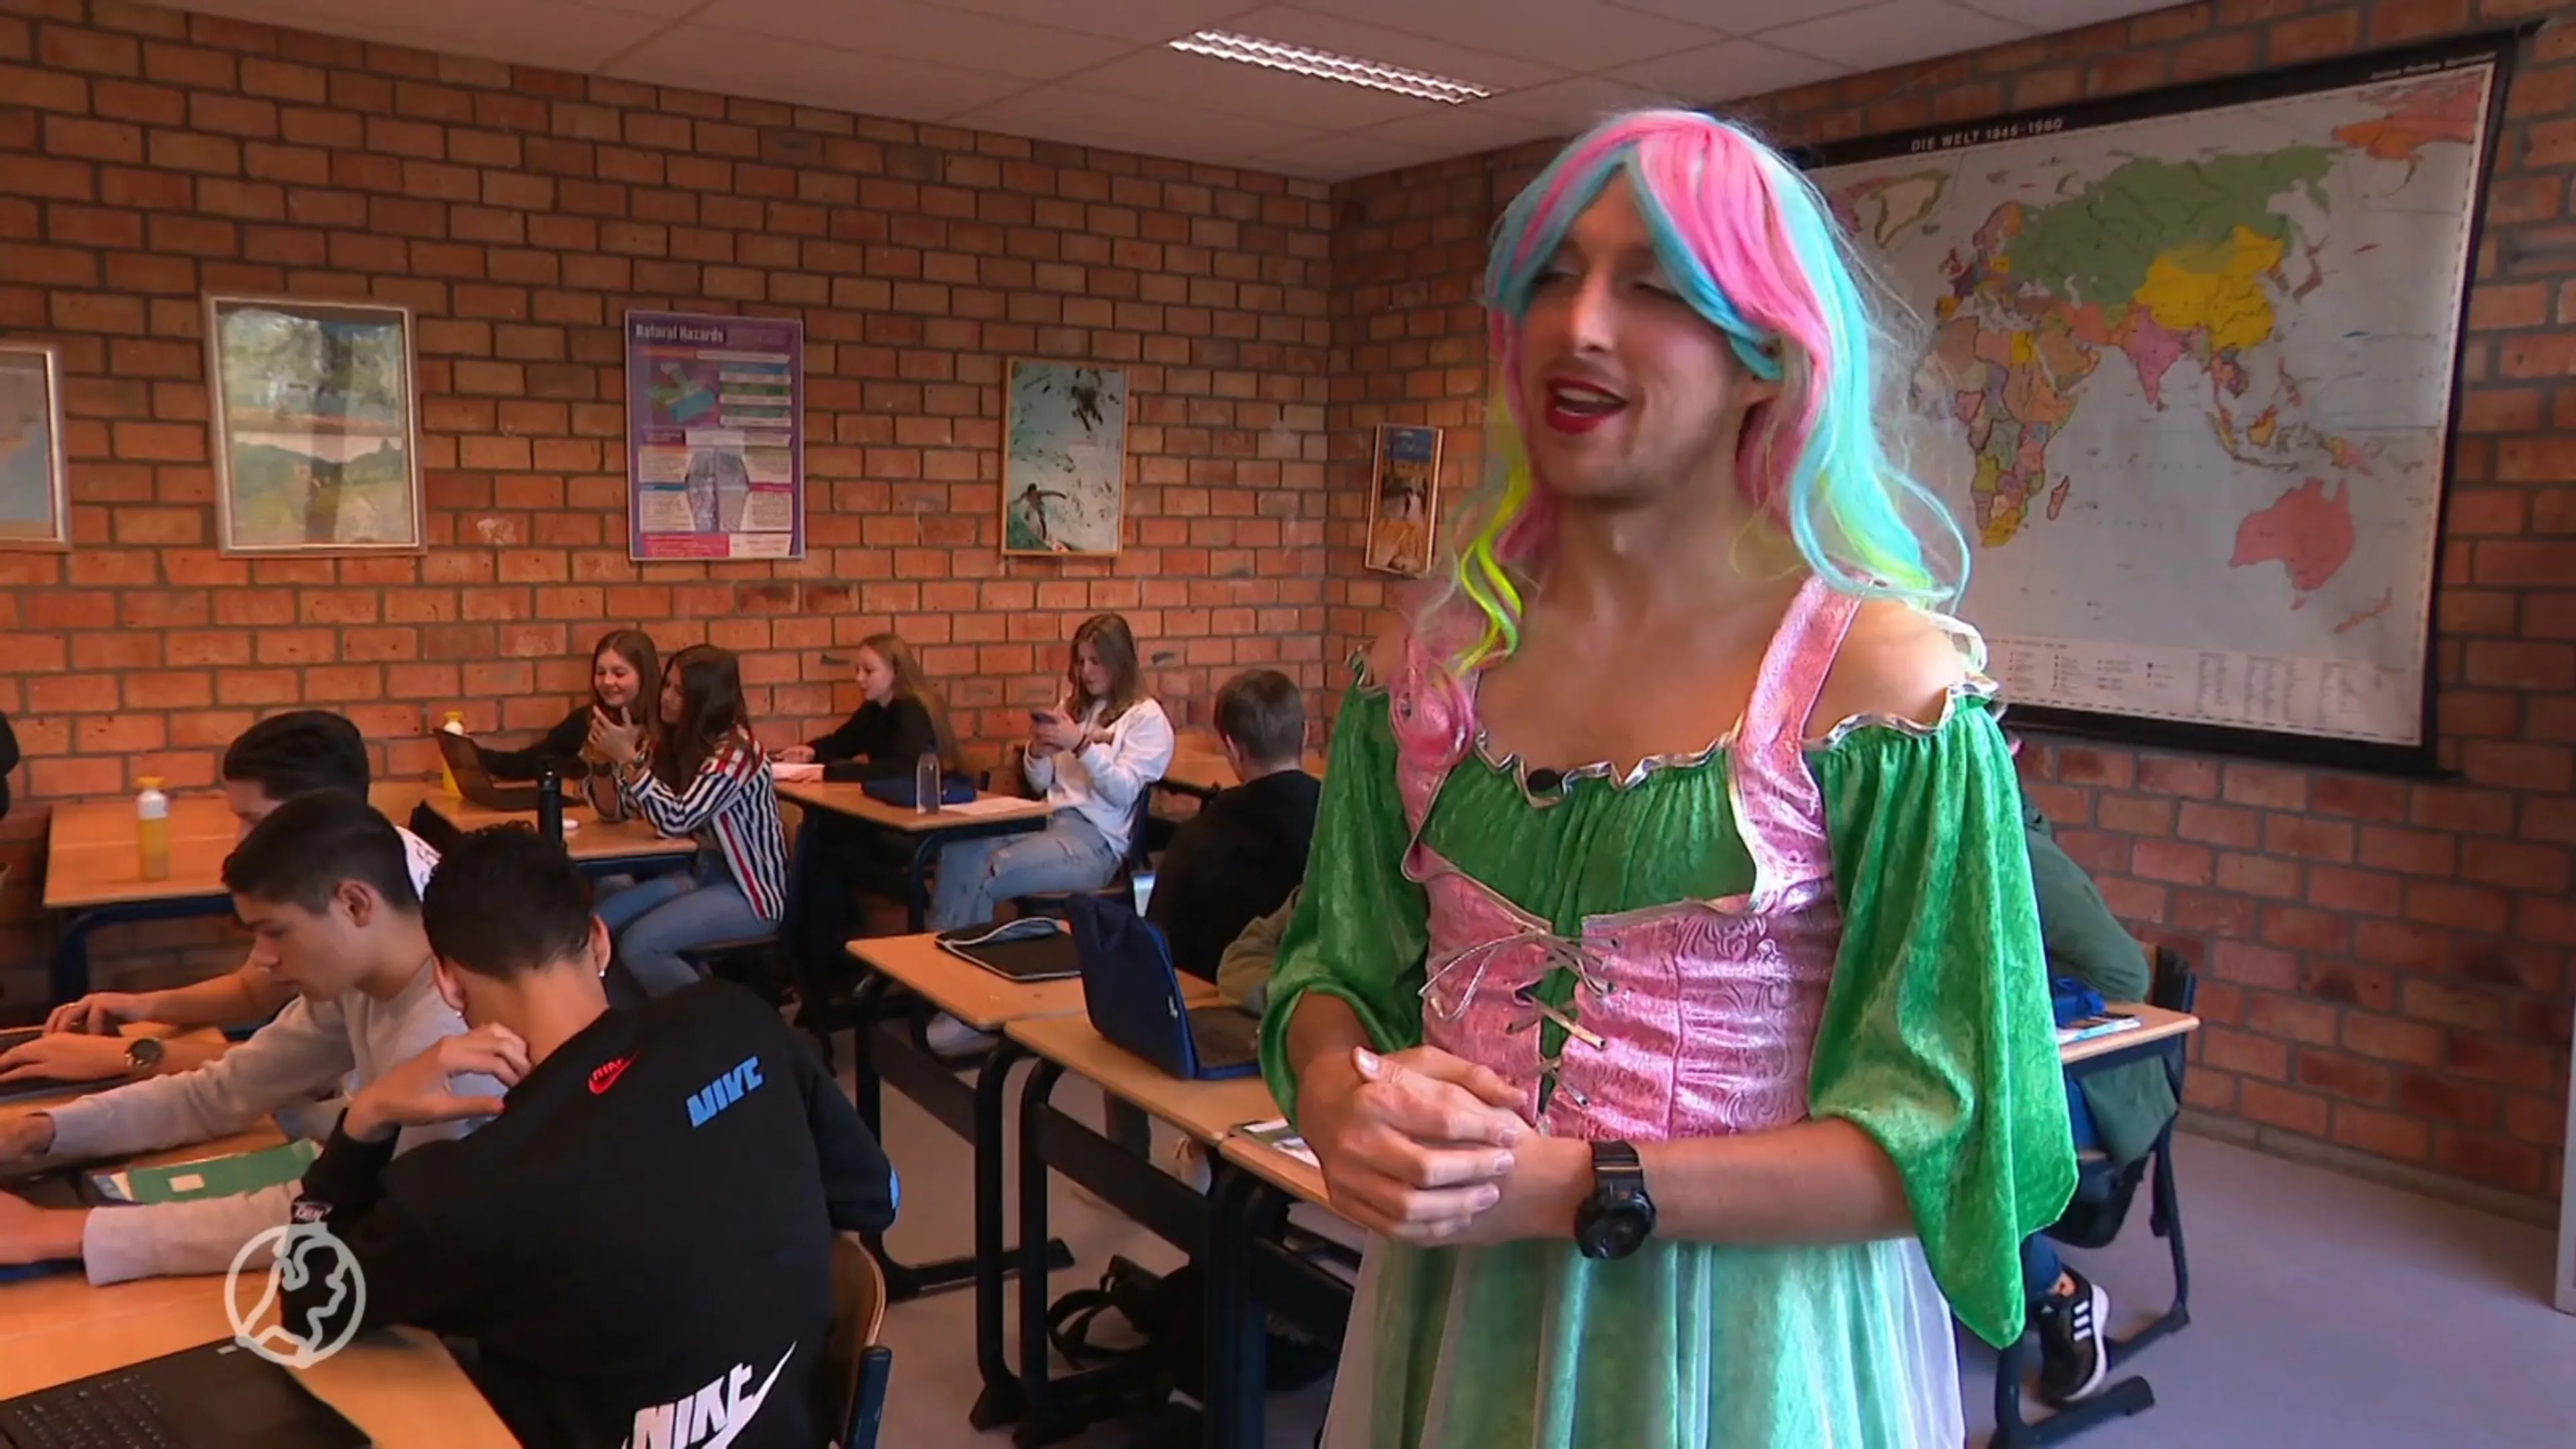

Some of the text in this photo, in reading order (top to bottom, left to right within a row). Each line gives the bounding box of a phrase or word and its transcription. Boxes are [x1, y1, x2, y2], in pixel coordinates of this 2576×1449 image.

[1911, 136, 1935, 152] DIE
[1941, 129, 1980, 147] WELT
[636, 323, 724, 343] Natural Hazards
[633, 1362, 753, 1449] NIKE
